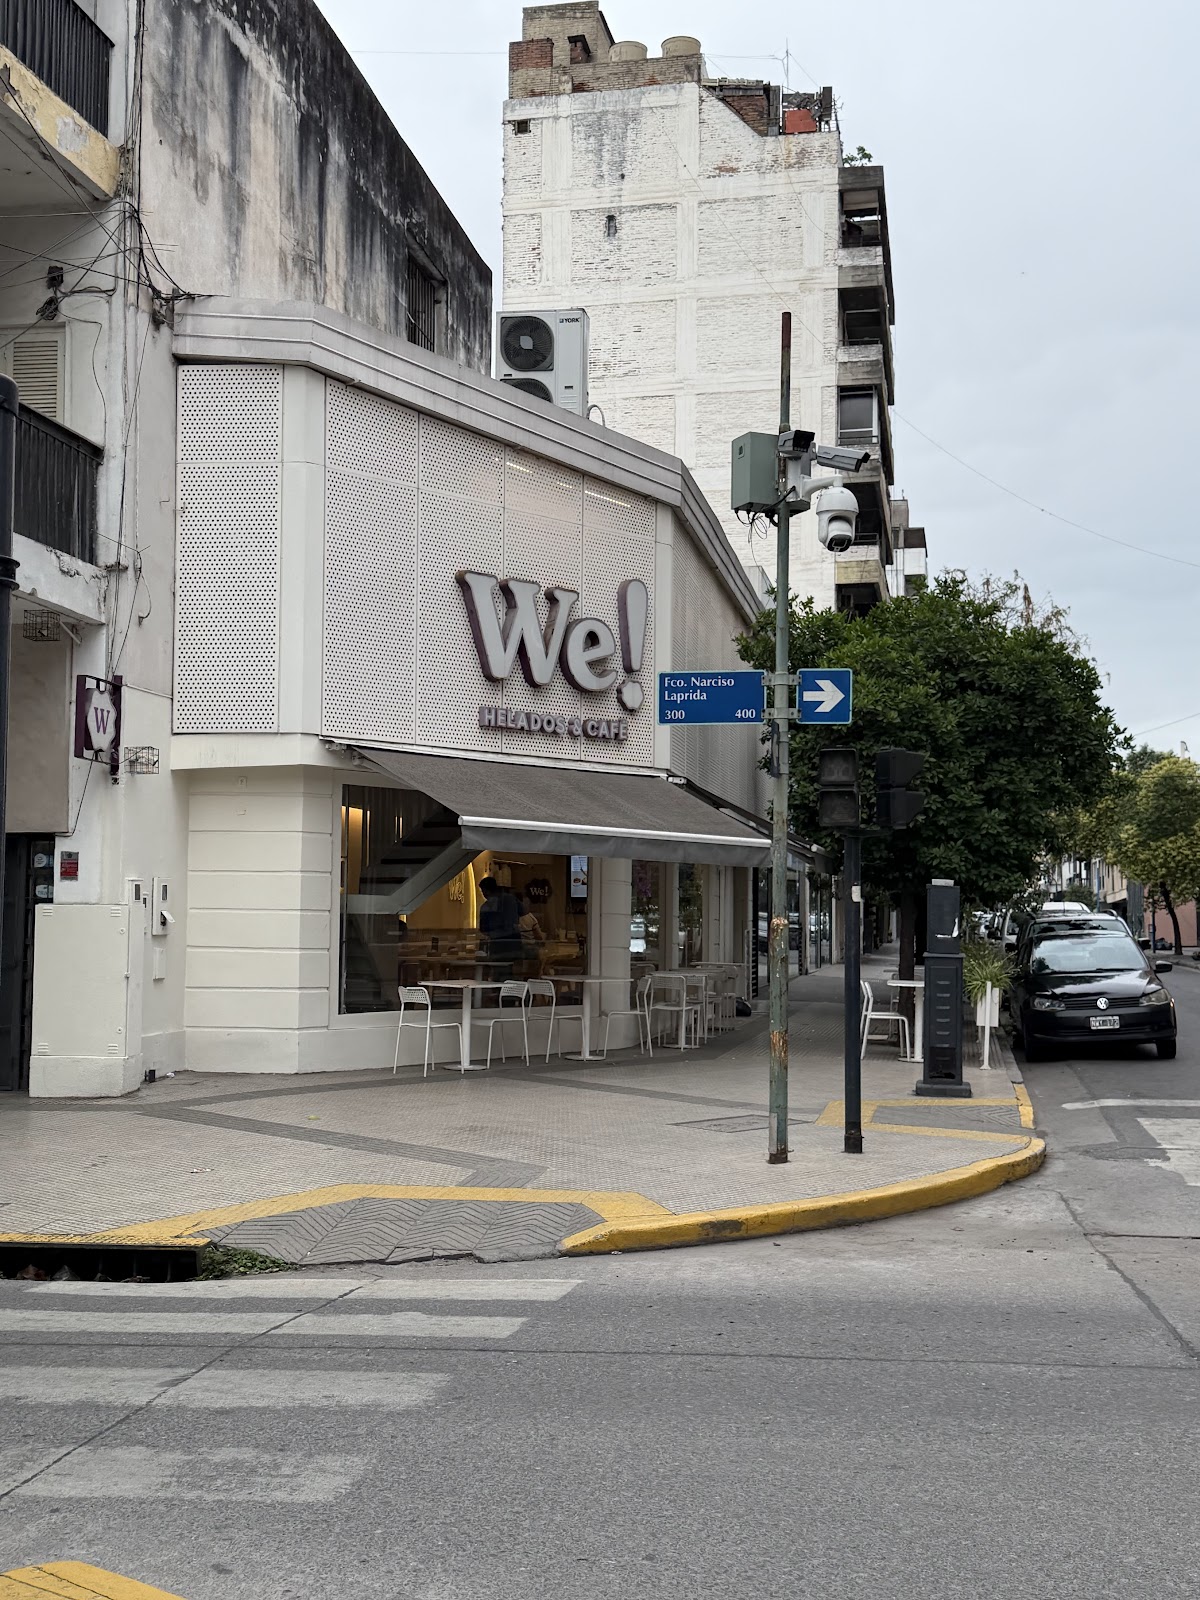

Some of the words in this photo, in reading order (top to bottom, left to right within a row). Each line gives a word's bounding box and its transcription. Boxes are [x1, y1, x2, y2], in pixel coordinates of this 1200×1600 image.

[455, 570, 649, 712] We!
[664, 677, 688, 687] Fco.
[691, 676, 735, 687] Narciso
[664, 690, 707, 704] Laprida
[93, 706, 111, 735] W
[664, 709, 686, 720] 300
[735, 708, 756, 719] 400
[479, 706, 567, 735] HELADOS
[567, 717, 583, 737] &
[530, 886, 549, 896] We!
